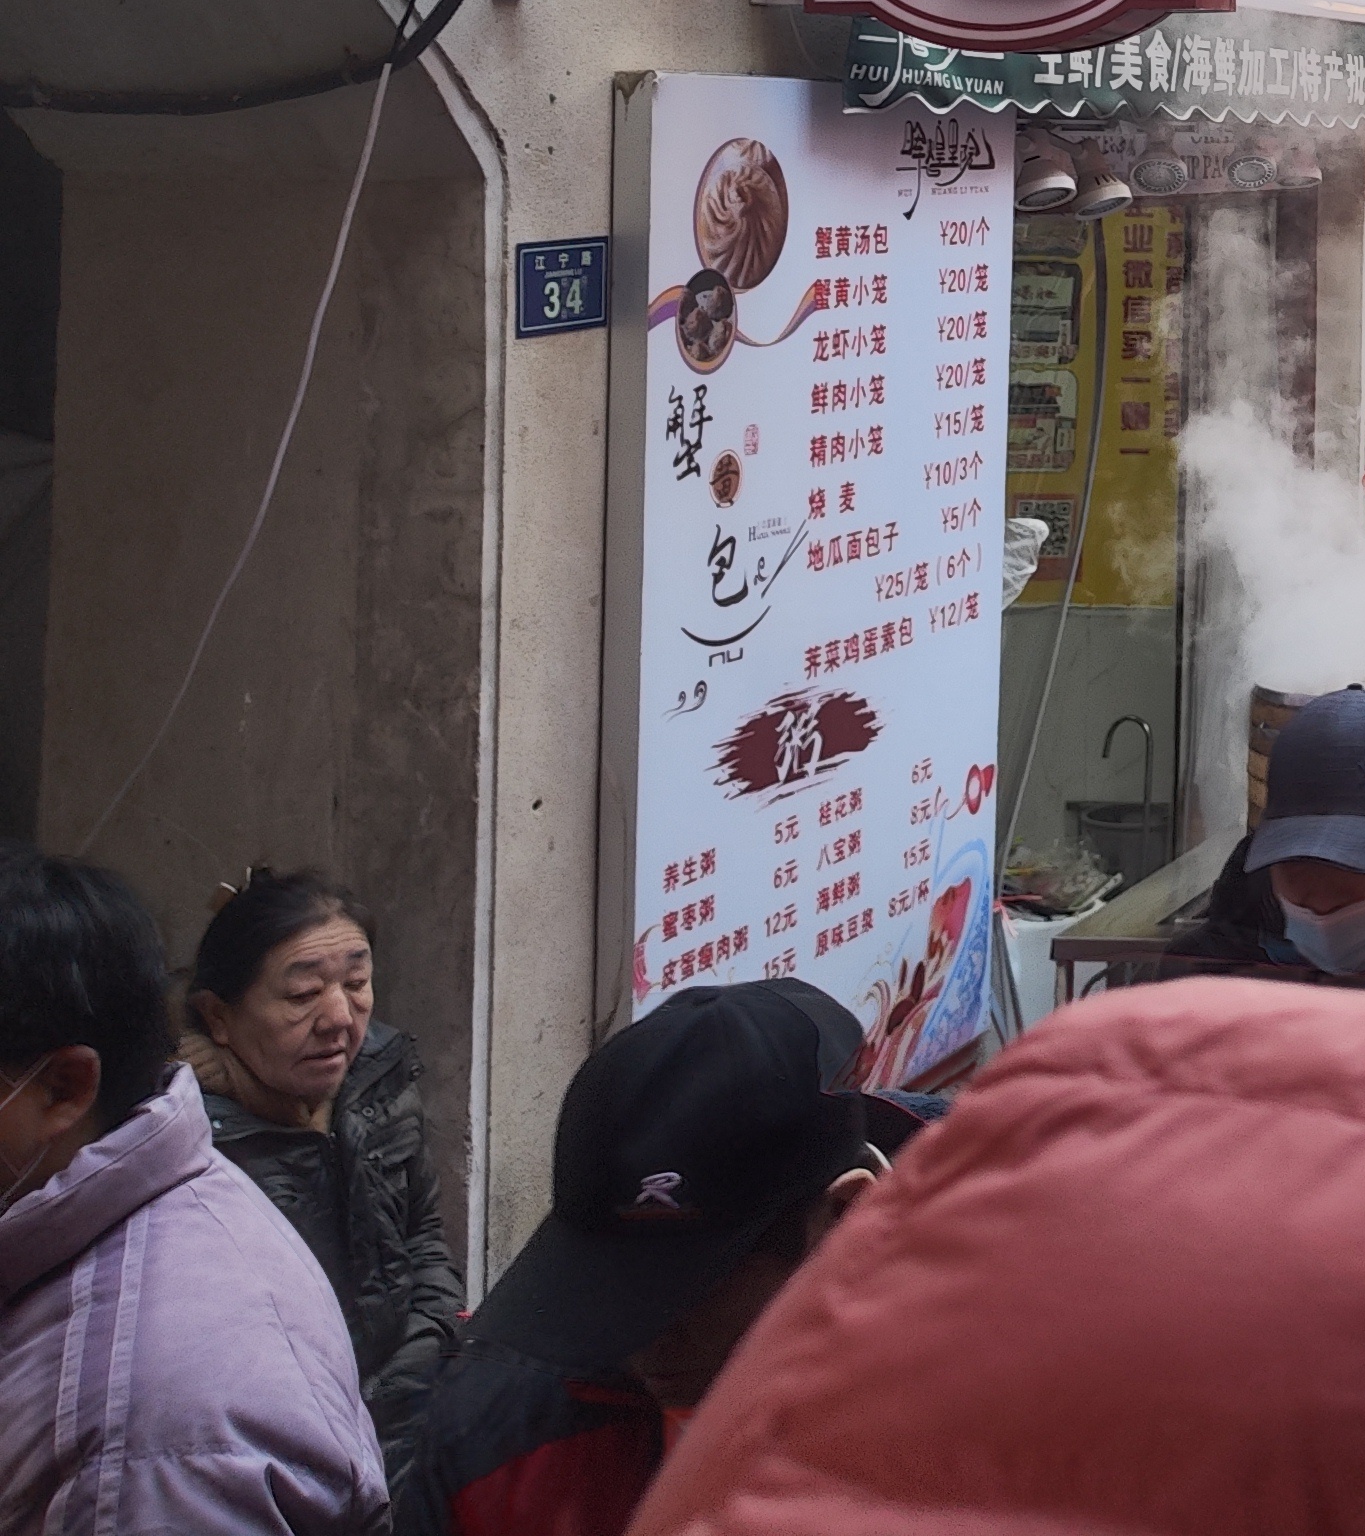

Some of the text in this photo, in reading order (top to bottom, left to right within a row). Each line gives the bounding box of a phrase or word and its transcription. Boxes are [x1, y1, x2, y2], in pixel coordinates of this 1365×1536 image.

[850, 64, 889, 82] HUI
[901, 68, 950, 89] HUANG
[964, 77, 1004, 95] YUAN
[815, 216, 991, 260] 蟹黄汤包 ¥20/个
[543, 278, 583, 319] 34
[814, 264, 990, 310] 蟹黄小笼 ¥20/笼
[812, 310, 989, 364] 龙虾小笼 ¥20/笼
[810, 358, 987, 415] 鲜肉小笼 ¥20/笼
[808, 404, 986, 467] 精肉小笼 ¥15/笼
[923, 451, 984, 488] ¥10/3个
[806, 521, 899, 572] 地瓜面包子
[941, 498, 982, 534] ¥5/个
[928, 592, 981, 634] ¥12/笼
[817, 757, 934, 828] 桂花粥 6元
[661, 815, 799, 894] 养生粥 5元
[816, 796, 933, 871] 八宝粥 8元
[660, 859, 799, 943] 蜜枣粥 6元
[814, 839, 932, 916] 海鲜粥 15元
[813, 876, 931, 958] 原味豆浆 8元/杯
[659, 904, 798, 992] 皮蛋瘦肉粥 12元
[762, 948, 798, 980] 15元
